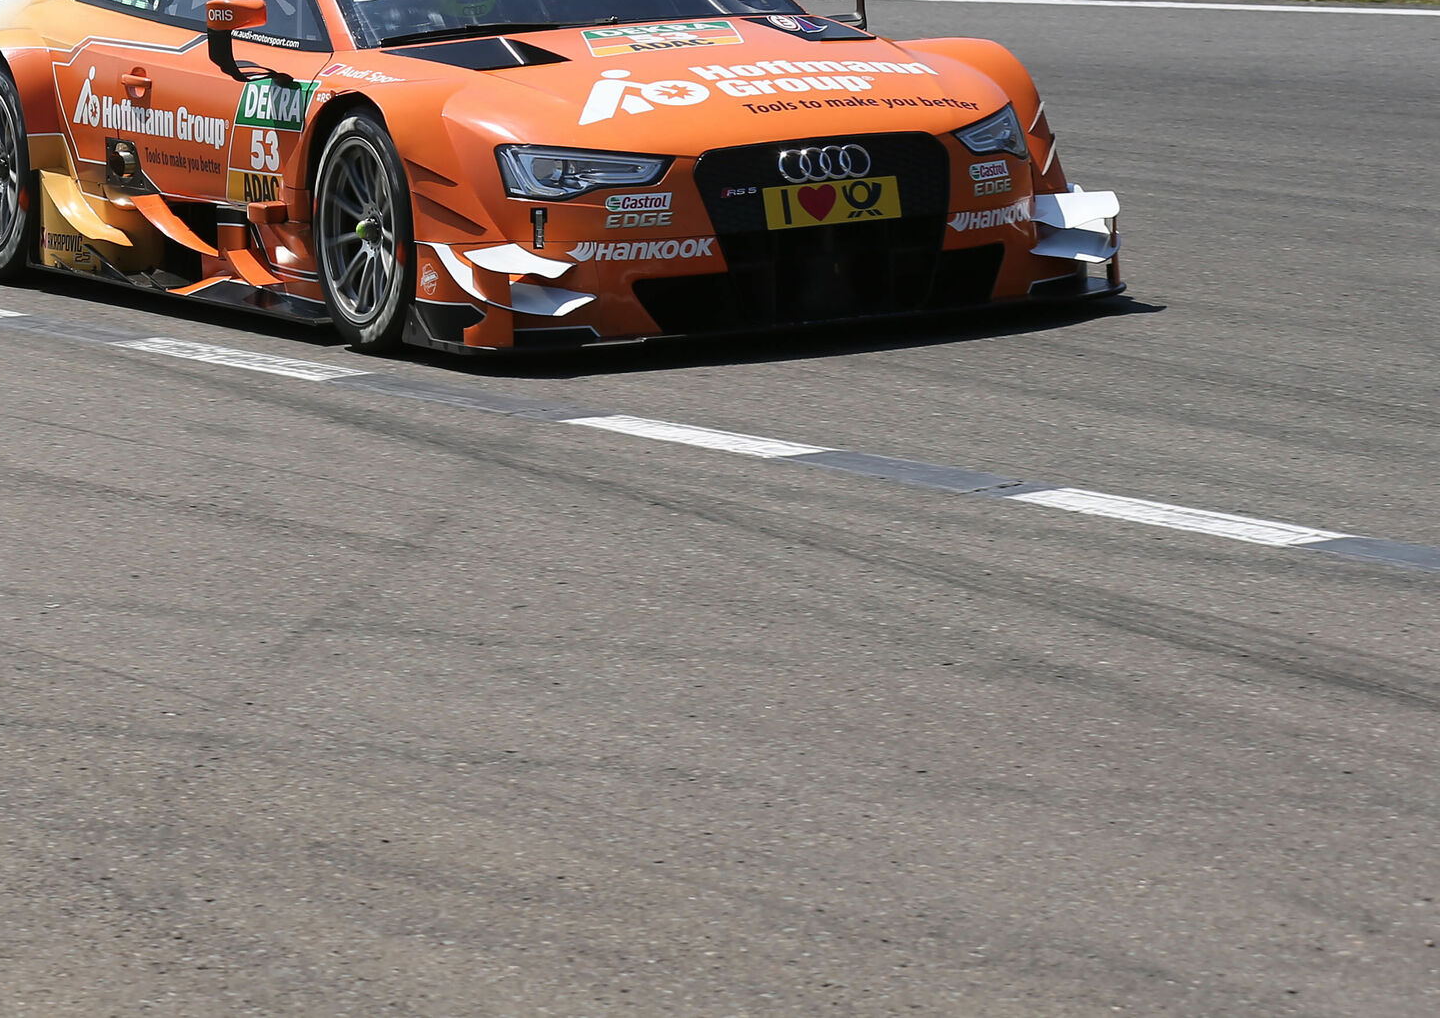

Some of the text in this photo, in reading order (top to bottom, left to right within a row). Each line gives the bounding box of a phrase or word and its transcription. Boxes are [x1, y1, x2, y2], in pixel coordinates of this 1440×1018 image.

[208, 9, 234, 21] ORIS
[589, 20, 718, 38] DEKRA
[630, 39, 715, 52] ADAC
[338, 66, 369, 79] Audi
[689, 60, 939, 80] Hoffmann
[244, 83, 301, 122] DEKRA
[742, 97, 979, 115] Tools to make you better
[102, 95, 174, 138] Hoffmann
[250, 129, 280, 172] 53
[145, 147, 221, 174] Tools to make you better
[980, 162, 1007, 178] Castrol
[244, 173, 280, 202] ADAC
[726, 188, 745, 197] RS
[974, 178, 1013, 197] EDGE
[621, 195, 667, 210] Castrol
[605, 212, 674, 229] EDGE
